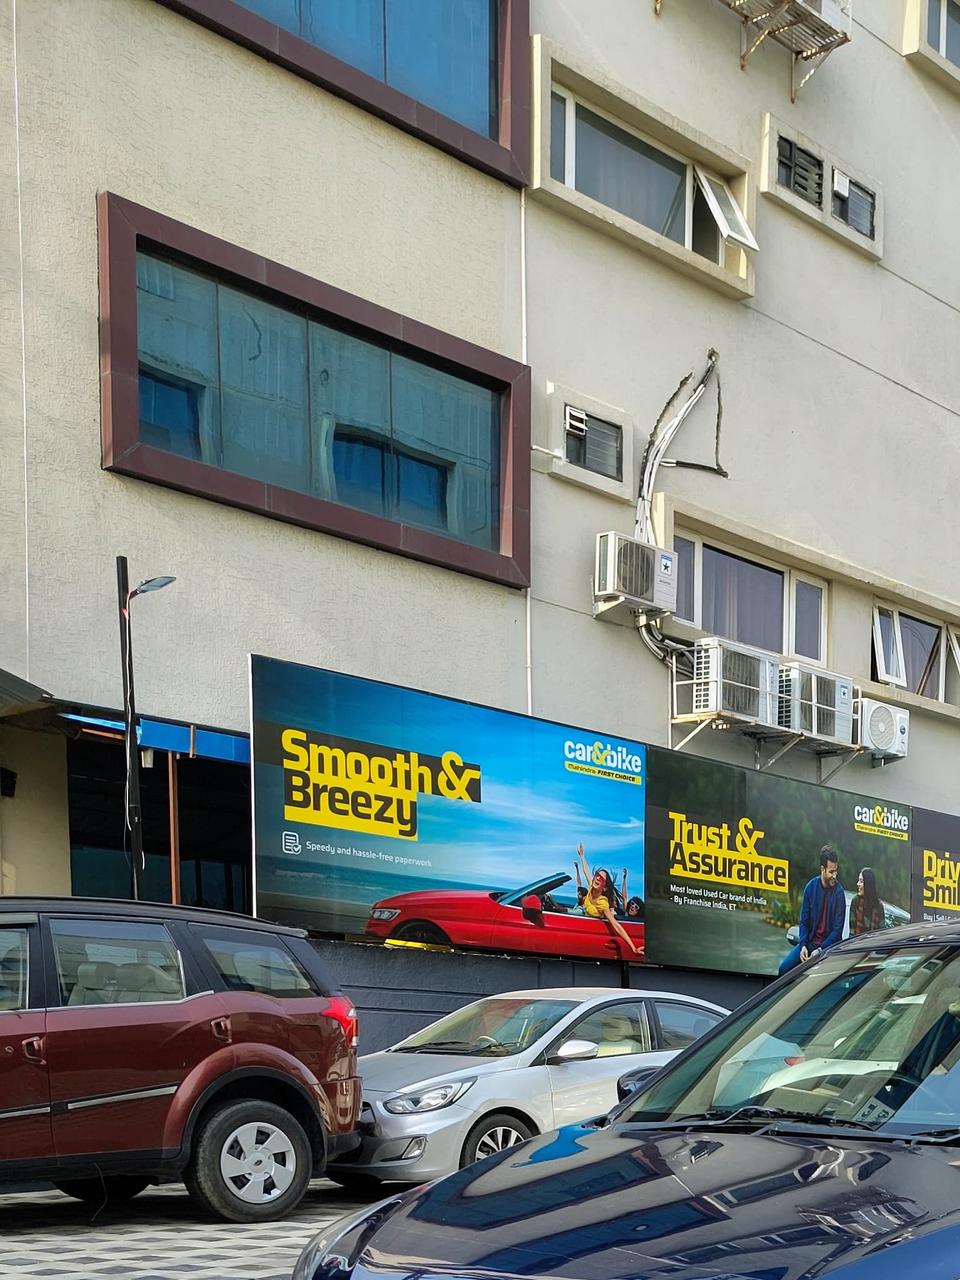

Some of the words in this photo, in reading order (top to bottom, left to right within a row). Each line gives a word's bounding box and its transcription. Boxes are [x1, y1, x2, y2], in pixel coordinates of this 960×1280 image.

[281, 729, 432, 795] Smooth
[438, 751, 481, 801] &
[564, 740, 642, 773] car&bike
[597, 769, 615, 779] FIRST
[615, 773, 636, 782] CHOICE
[284, 767, 418, 838] Breezy
[854, 805, 909, 831] car&bike
[669, 811, 731, 851] Trust
[736, 817, 765, 856] &
[306, 840, 336, 855] Speedy
[336, 846, 351, 856] and
[352, 849, 394, 862] hassle-free
[394, 856, 432, 868] paperwork
[670, 841, 787, 888] Assurance
[670, 884, 686, 894] Most
[686, 886, 703, 896] loved
[703, 888, 718, 898] Used
[719, 891, 729, 900] Car
[729, 892, 746, 902] brand
[746, 895, 753, 903] of
[753, 896, 767, 905] India
[673, 895, 682, 905] By
[683, 896, 712, 908] Franchise
[728, 903, 737, 911] ET
